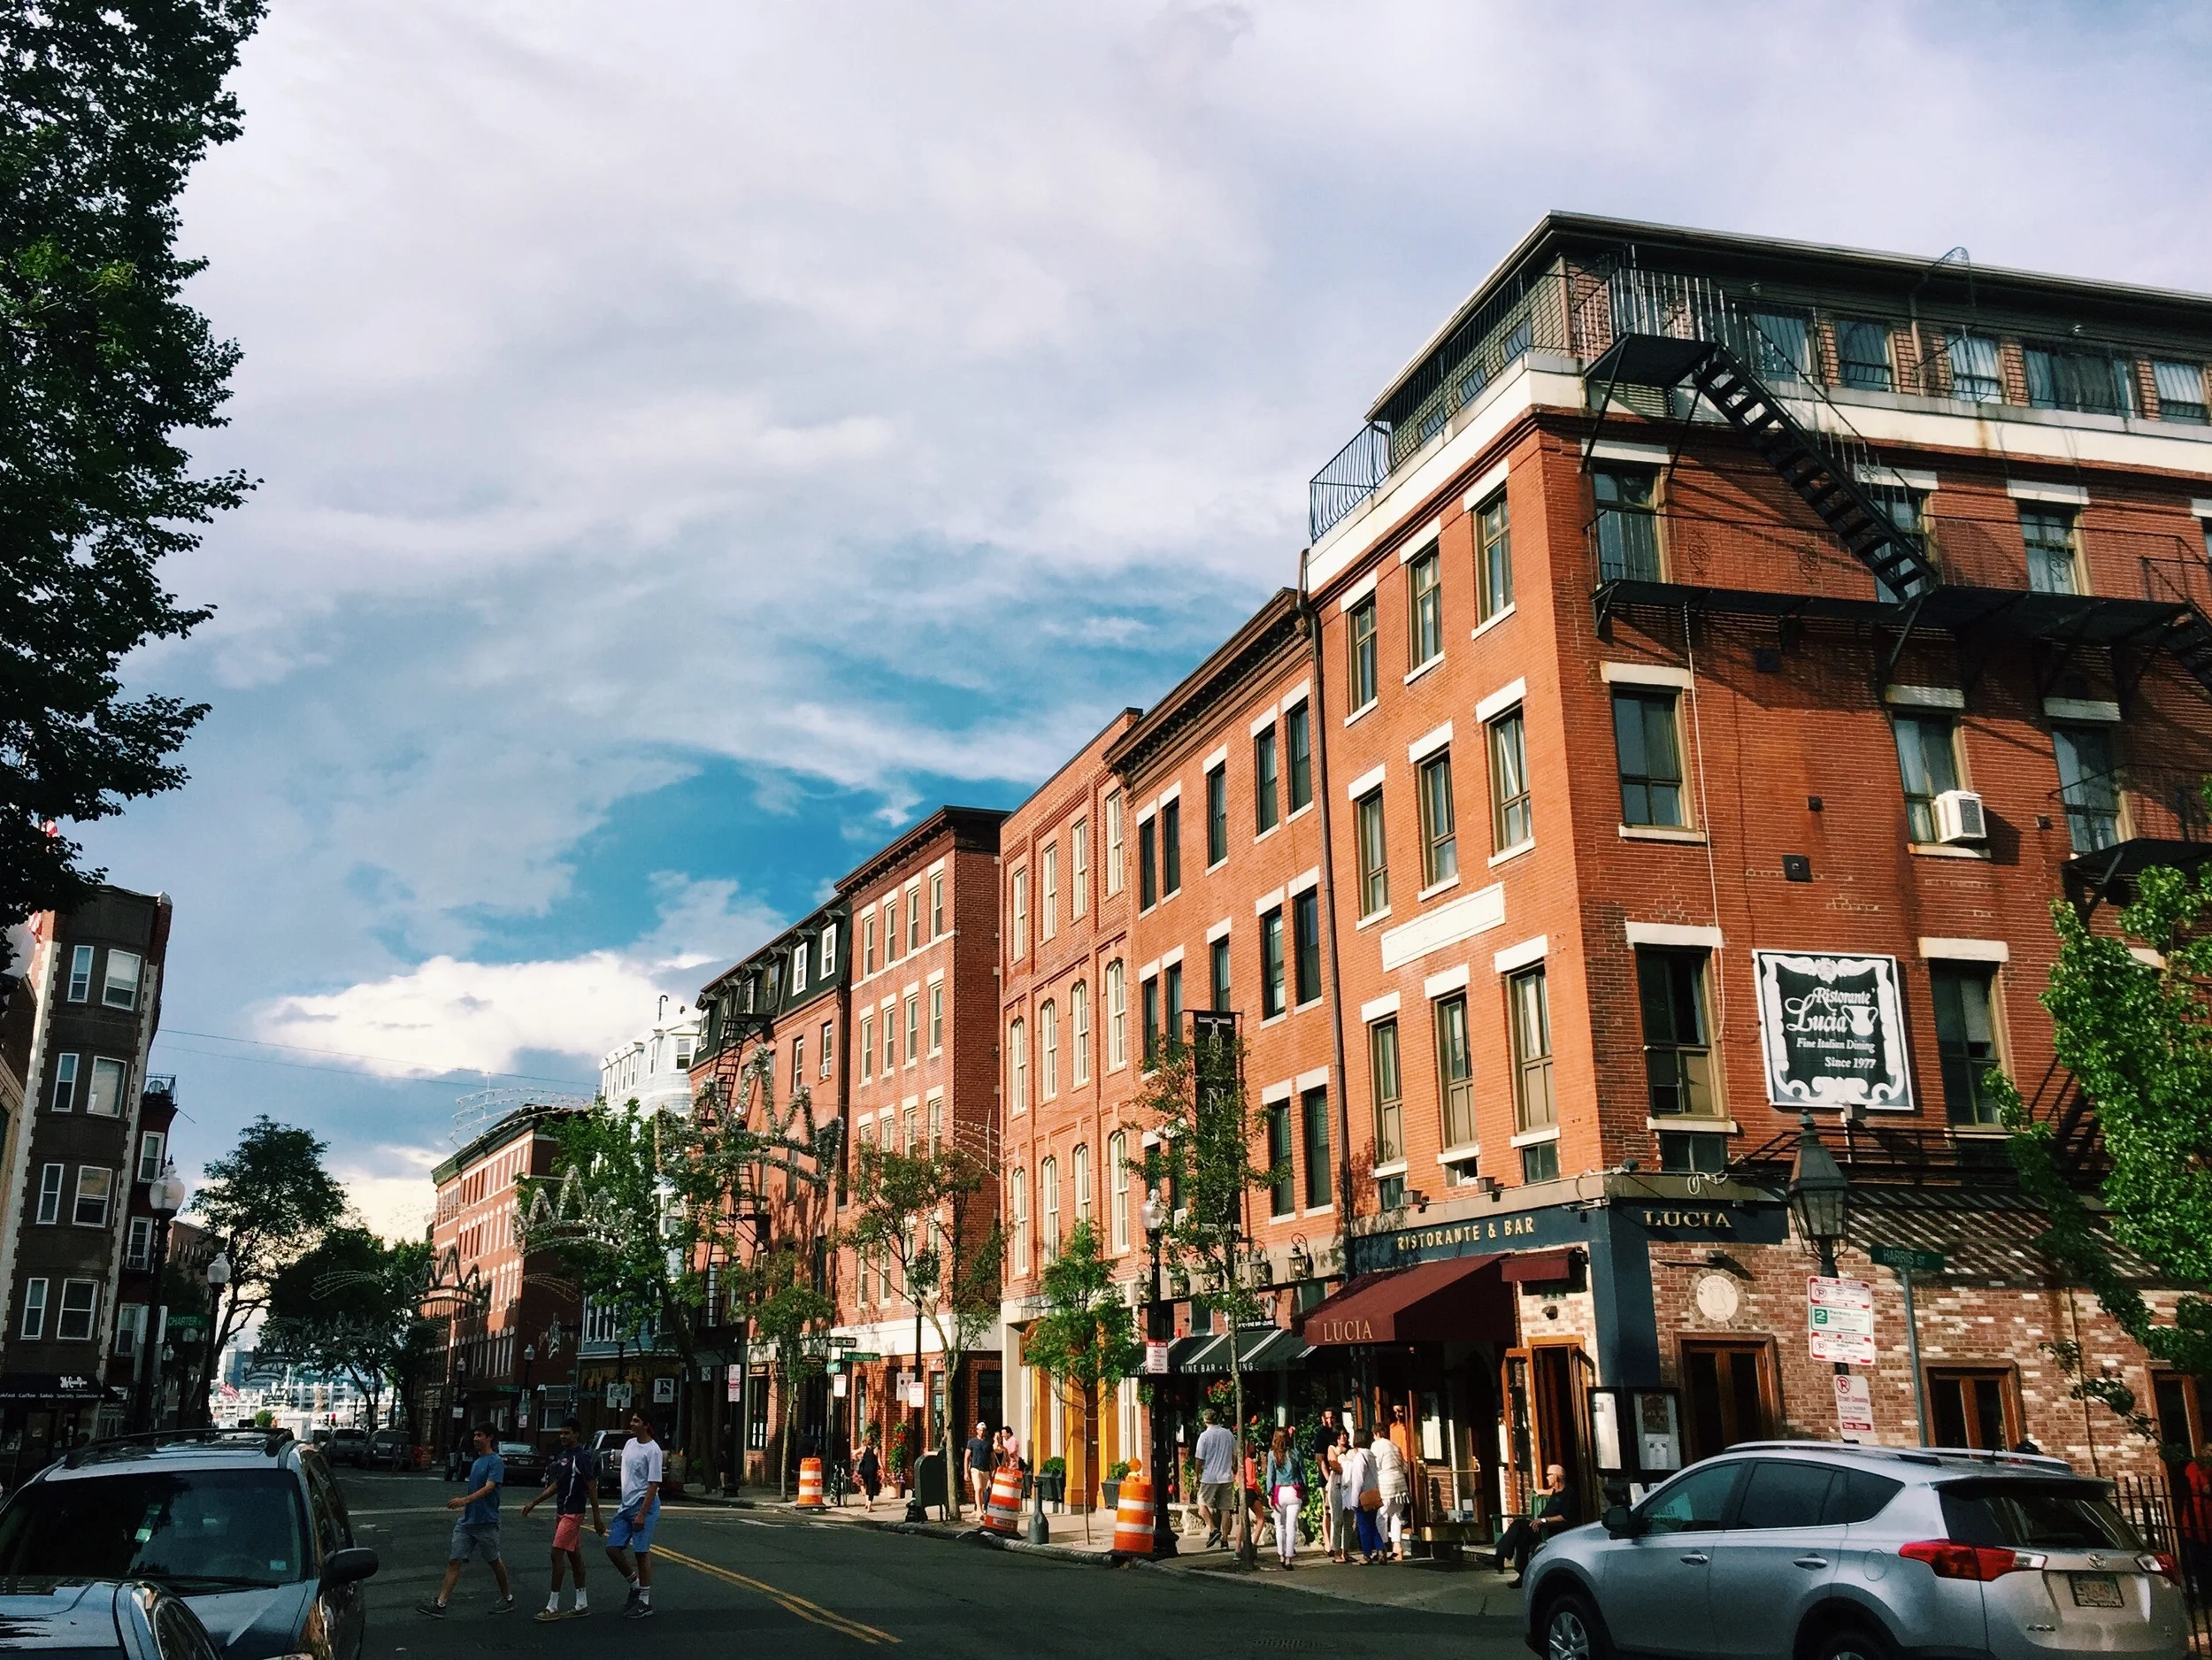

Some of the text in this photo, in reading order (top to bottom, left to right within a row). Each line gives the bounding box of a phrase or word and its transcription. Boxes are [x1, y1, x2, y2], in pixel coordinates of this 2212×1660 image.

[1785, 994, 1847, 1033] Lucia
[1796, 1038, 1875, 1053] Fine Italian Dining
[1824, 1057, 1877, 1069] Since 1977
[1643, 1210, 1732, 1228] LUCIA
[1397, 1217, 1535, 1251] RISTORANTE & BAR
[1883, 1249, 1914, 1264] HARRIS
[167, 1316, 197, 1326] CHARTER
[1816, 1310, 1826, 1319] 2
[1324, 1319, 1373, 1342] LUCIA
[1179, 1364, 1197, 1373] WINE
[1201, 1363, 1216, 1372] BAR
